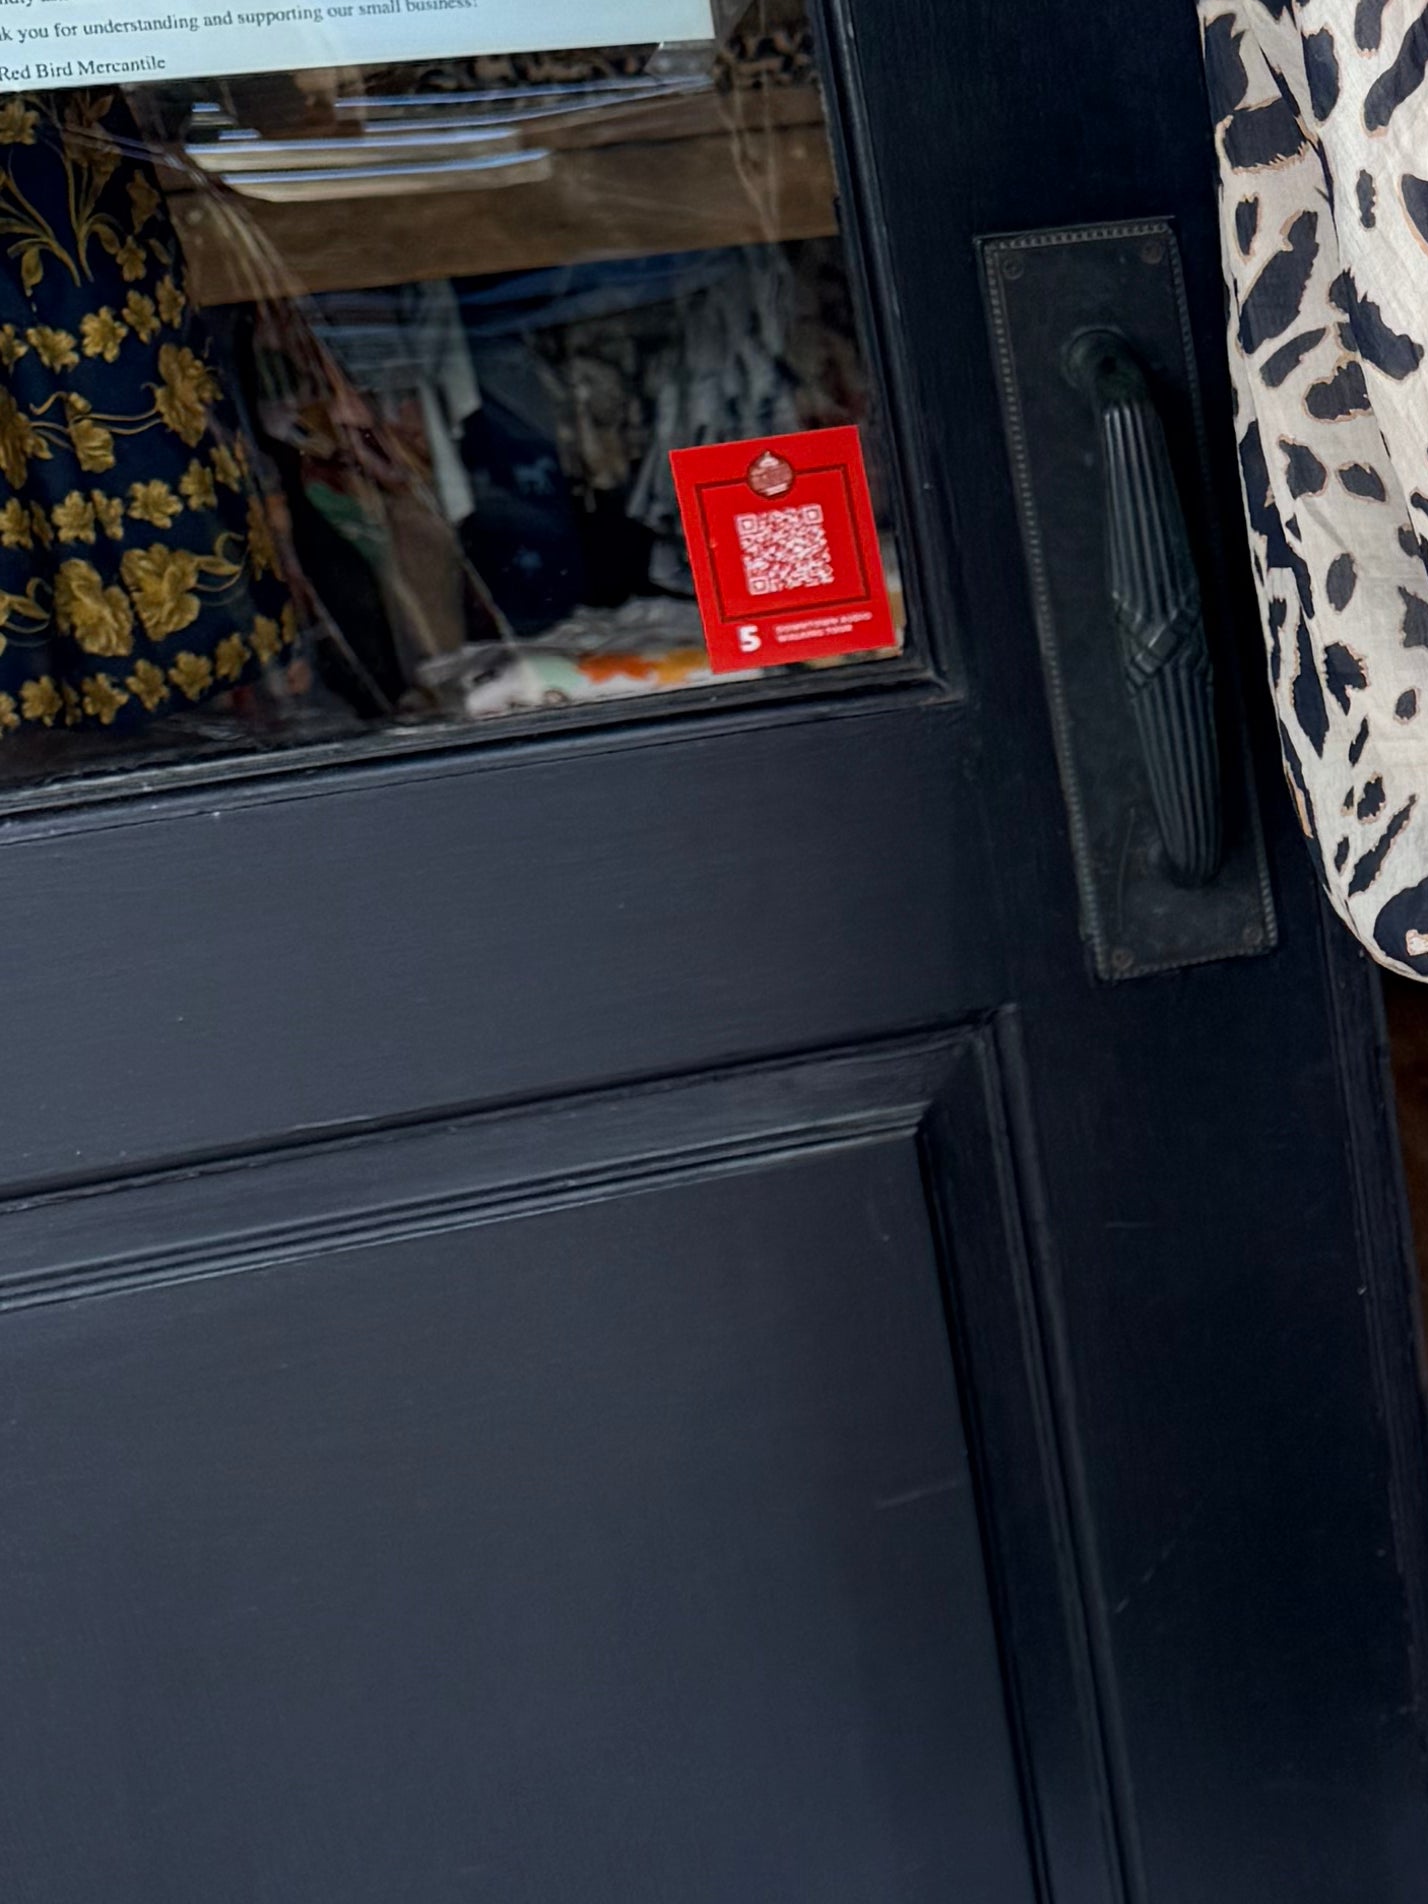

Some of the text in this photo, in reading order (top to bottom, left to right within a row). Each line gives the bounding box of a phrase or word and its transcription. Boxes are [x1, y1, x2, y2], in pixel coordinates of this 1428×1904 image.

[18, 27, 49, 44] you
[54, 23, 77, 38] for
[83, 14, 200, 36] understanding
[203, 10, 233, 26] and
[237, 3, 324, 27] supporting
[327, 5, 354, 18] our
[0, 55, 166, 81] Red Bird Mercantile
[739, 624, 761, 653] 5
